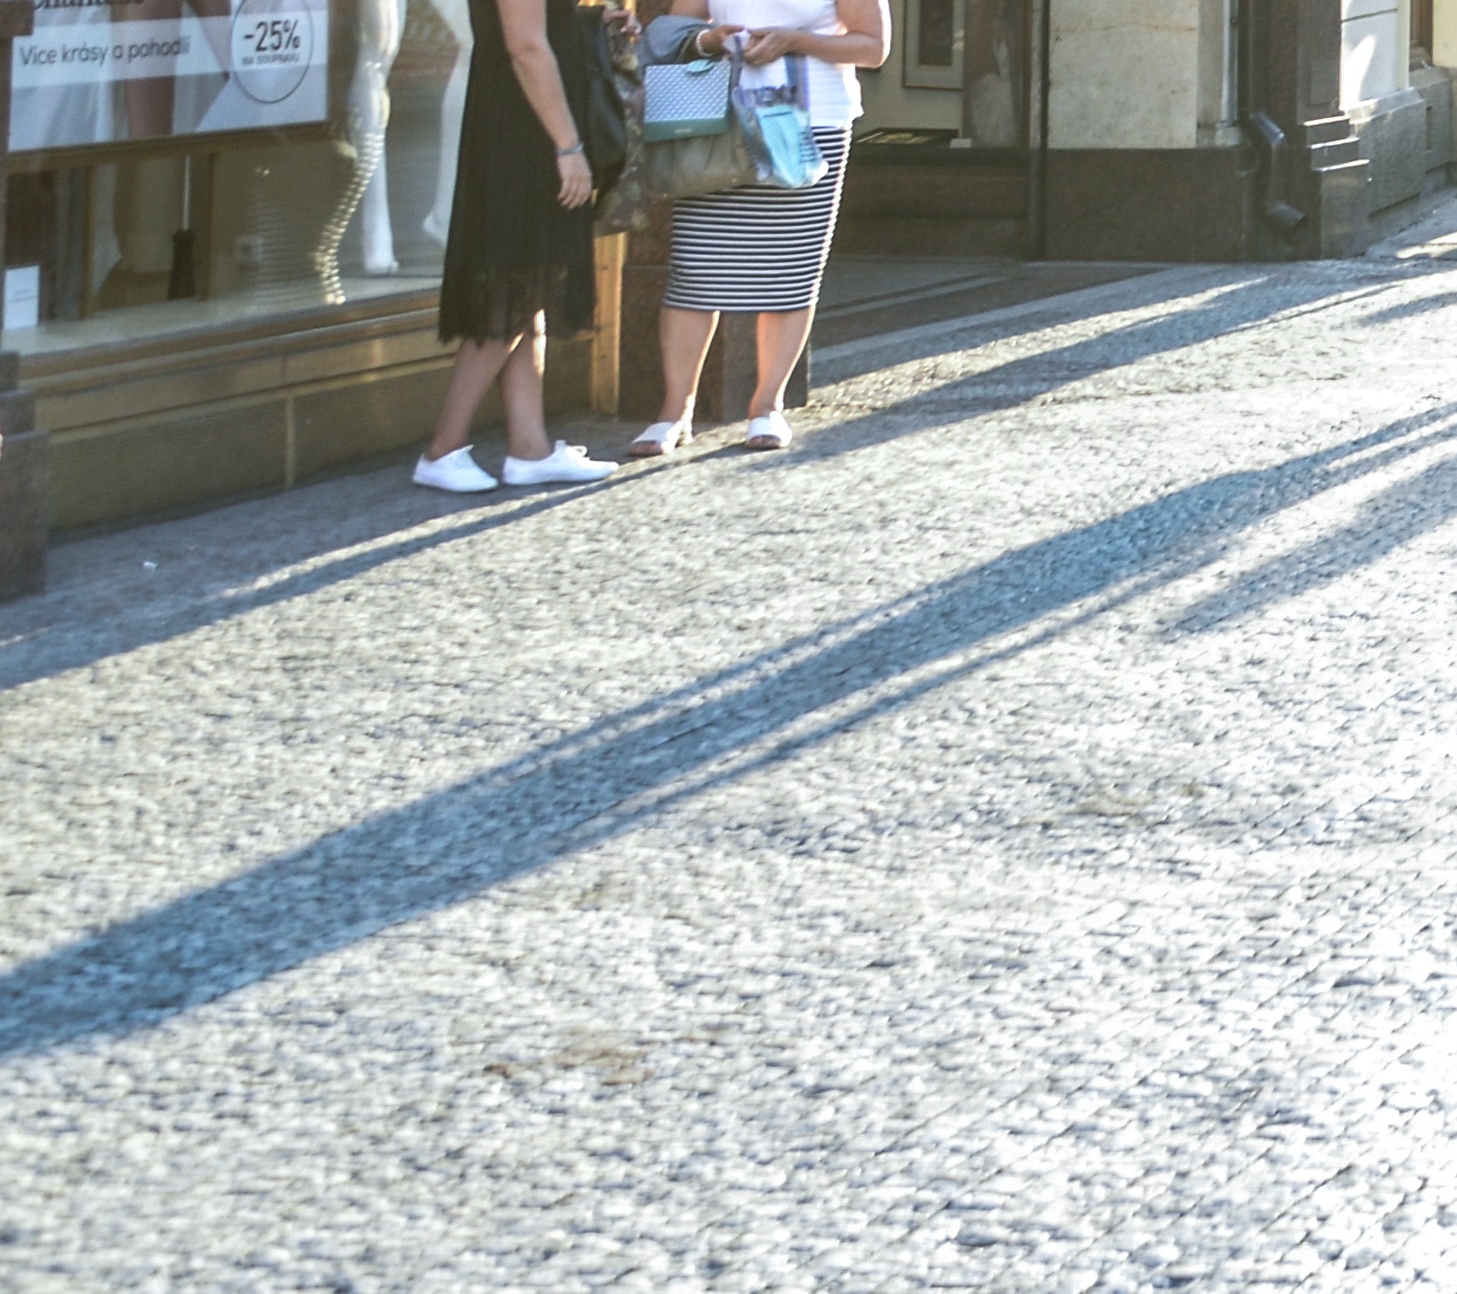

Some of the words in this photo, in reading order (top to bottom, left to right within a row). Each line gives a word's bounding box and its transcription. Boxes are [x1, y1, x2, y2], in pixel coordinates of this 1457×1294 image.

[244, 18, 301, 53] -25%
[61, 41, 109, 66] krásy
[112, 45, 124, 59] a
